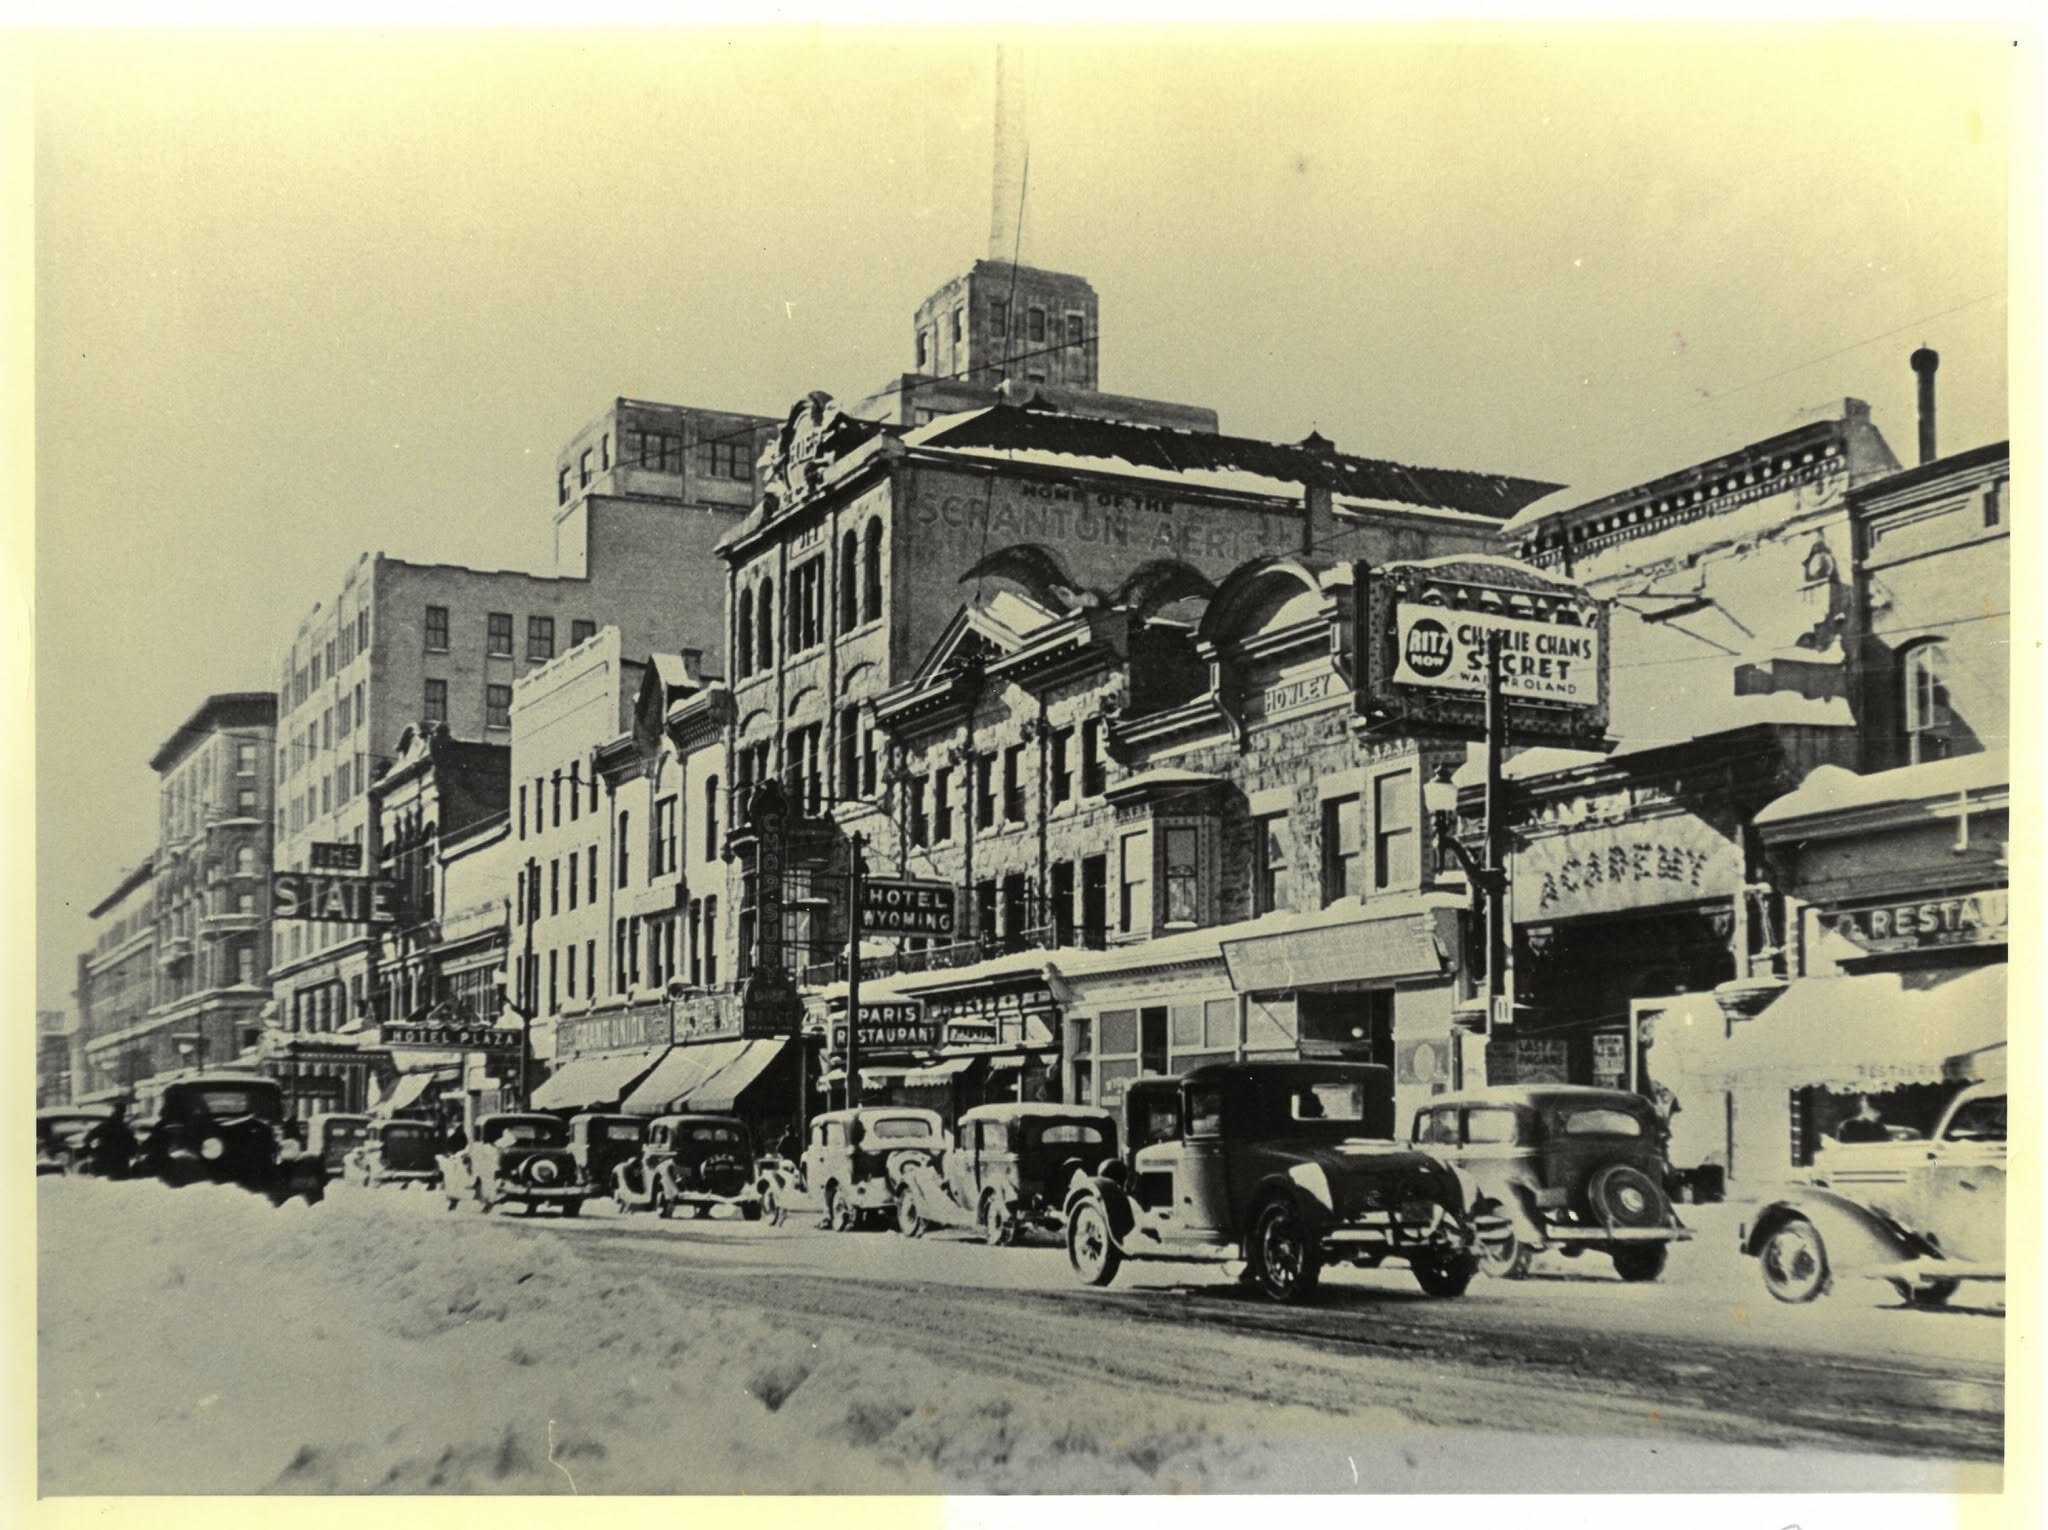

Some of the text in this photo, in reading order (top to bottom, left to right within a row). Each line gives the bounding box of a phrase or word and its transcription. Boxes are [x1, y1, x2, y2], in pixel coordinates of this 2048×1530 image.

[916, 492, 1129, 547] SCRANTON
[1409, 628, 1449, 655] RITZ
[1457, 624, 1530, 652] CHLIE
[1411, 653, 1445, 667] NOW
[1467, 650, 1571, 680] SCRET
[1266, 674, 1331, 712] HOWLEY
[1460, 672, 1577, 695] WALR OLAND
[315, 848, 358, 867] THE
[273, 876, 396, 921] STATE
[869, 888, 948, 909] HOTEL
[863, 909, 950, 930] WYOMING
[857, 1007, 917, 1023] PARIS
[392, 1031, 514, 1045] HOTEL PLAZA
[836, 1026, 936, 1045] RSTAURANT
